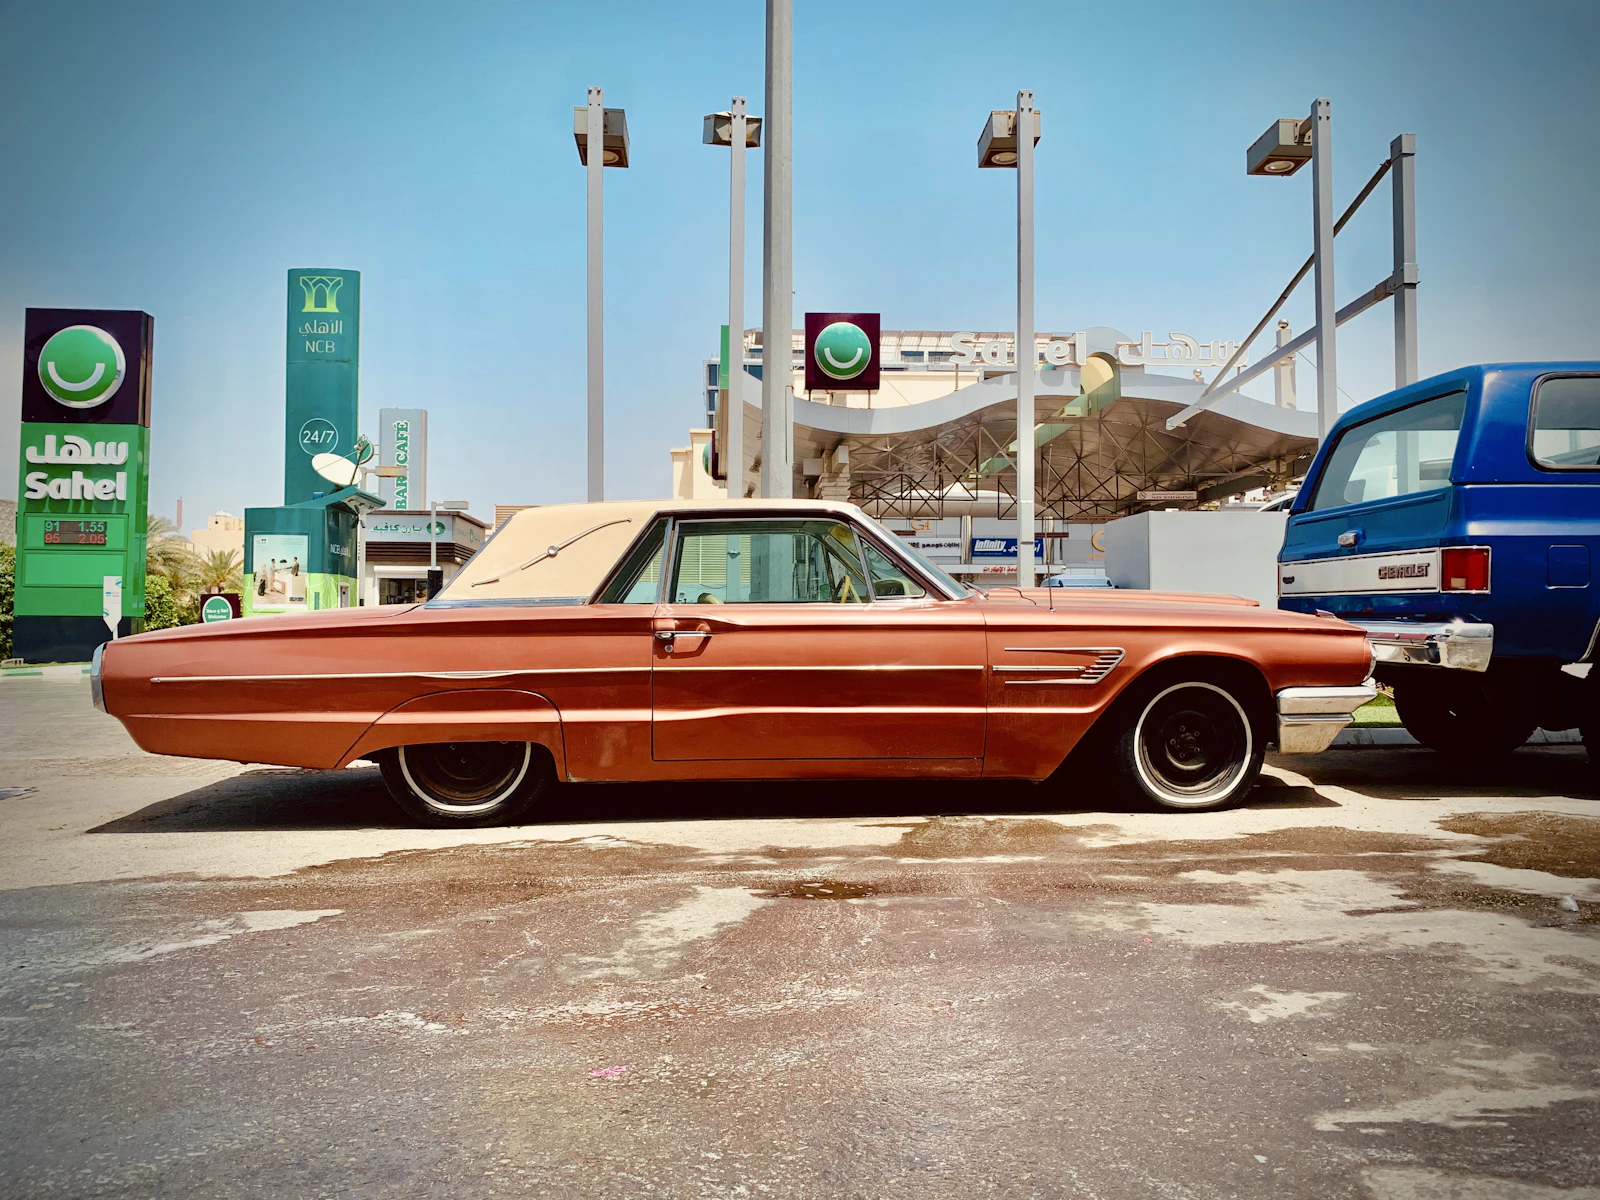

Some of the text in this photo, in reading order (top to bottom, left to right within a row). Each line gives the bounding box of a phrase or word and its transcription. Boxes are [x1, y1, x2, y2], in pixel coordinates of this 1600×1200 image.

[305, 340, 336, 353] NCB
[302, 430, 335, 444] 24/7
[25, 434, 129, 465] سهل
[24, 470, 128, 501] Sahel
[45, 522, 105, 532] 91 1.55
[45, 533, 106, 544] 95 2.05
[330, 543, 340, 555] NCB
[1378, 563, 1431, 579] CHEVROLET
